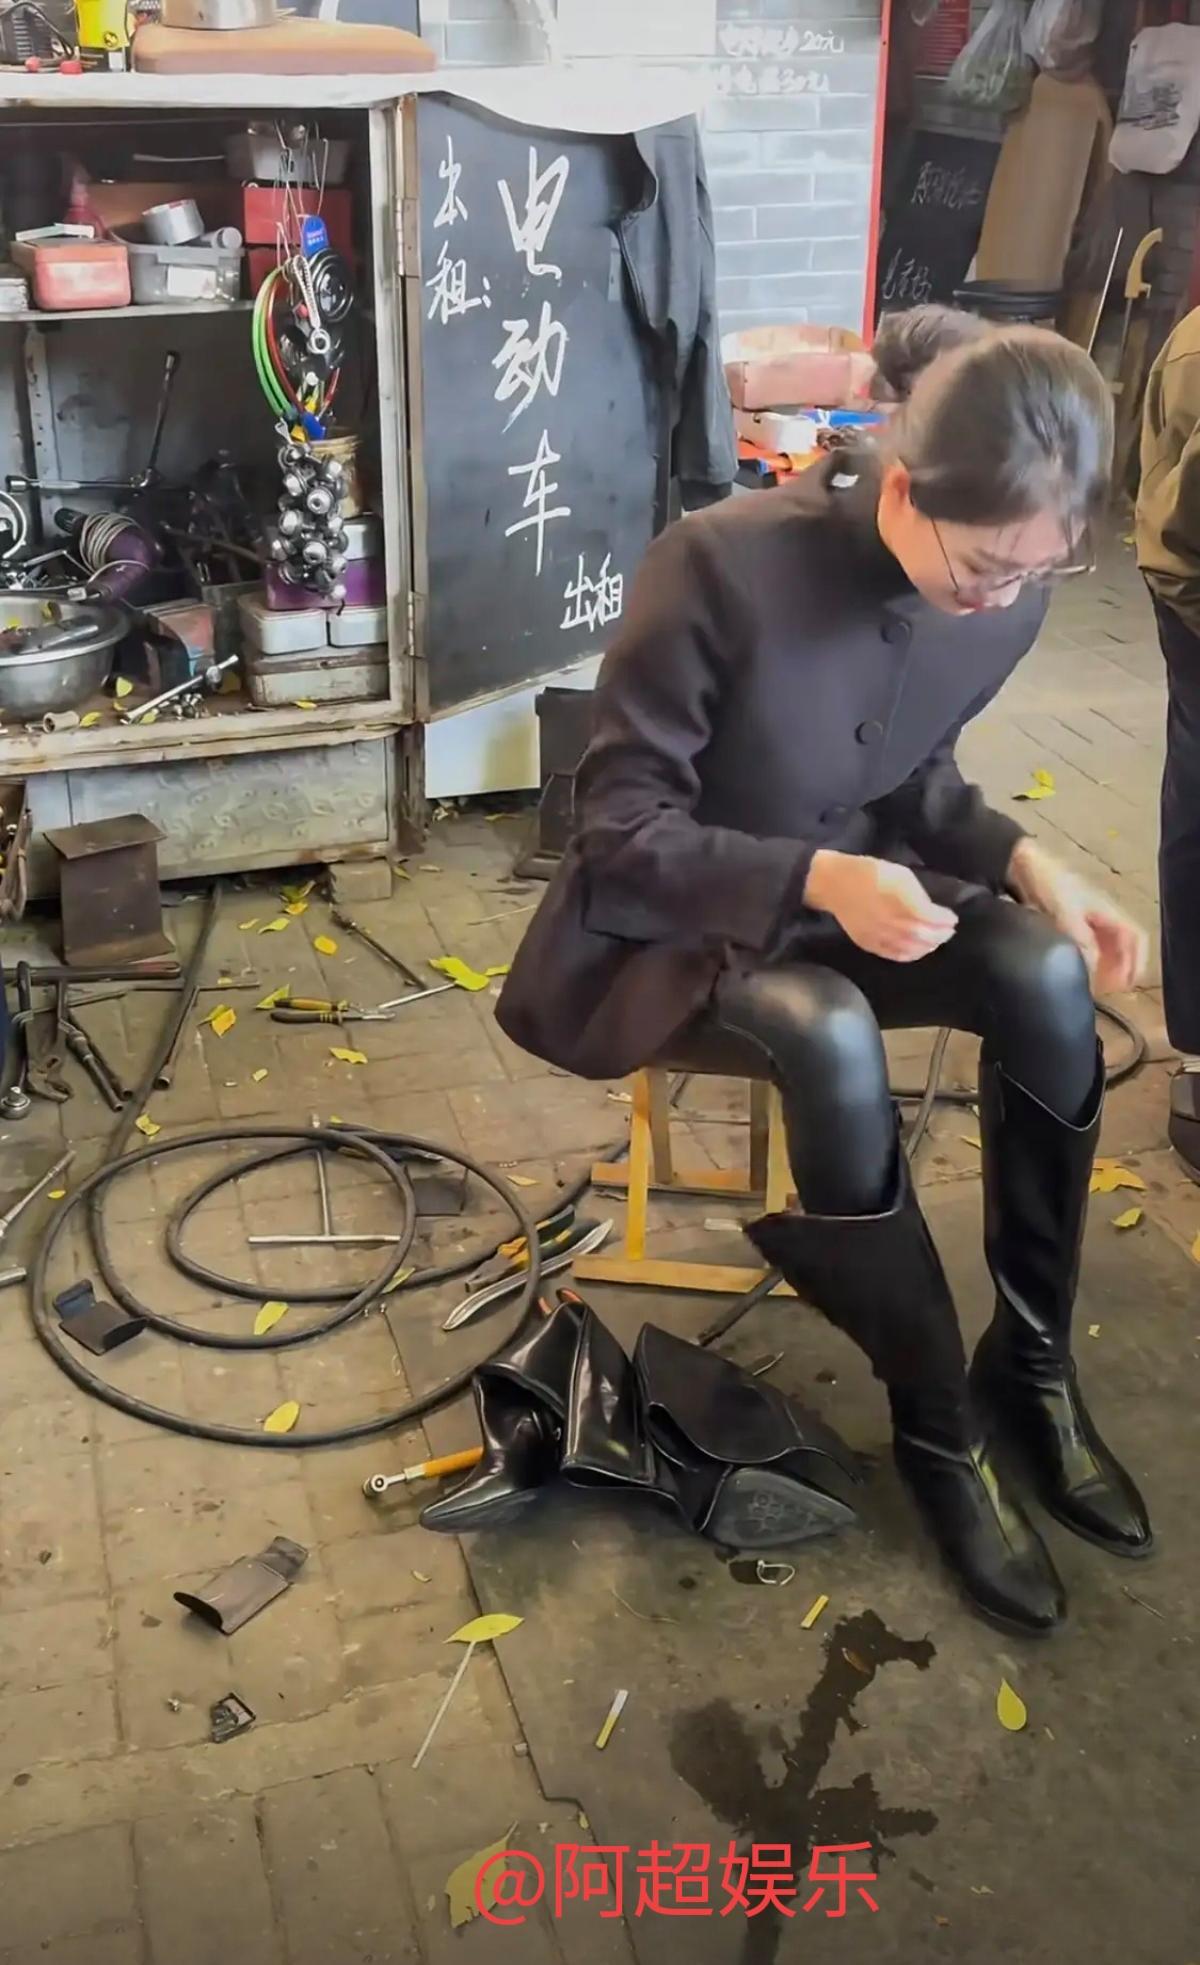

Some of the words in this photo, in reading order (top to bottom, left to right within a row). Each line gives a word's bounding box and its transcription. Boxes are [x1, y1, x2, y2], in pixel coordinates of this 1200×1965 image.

[491, 146, 571, 577] 电动车
[560, 552, 624, 633] 出租
